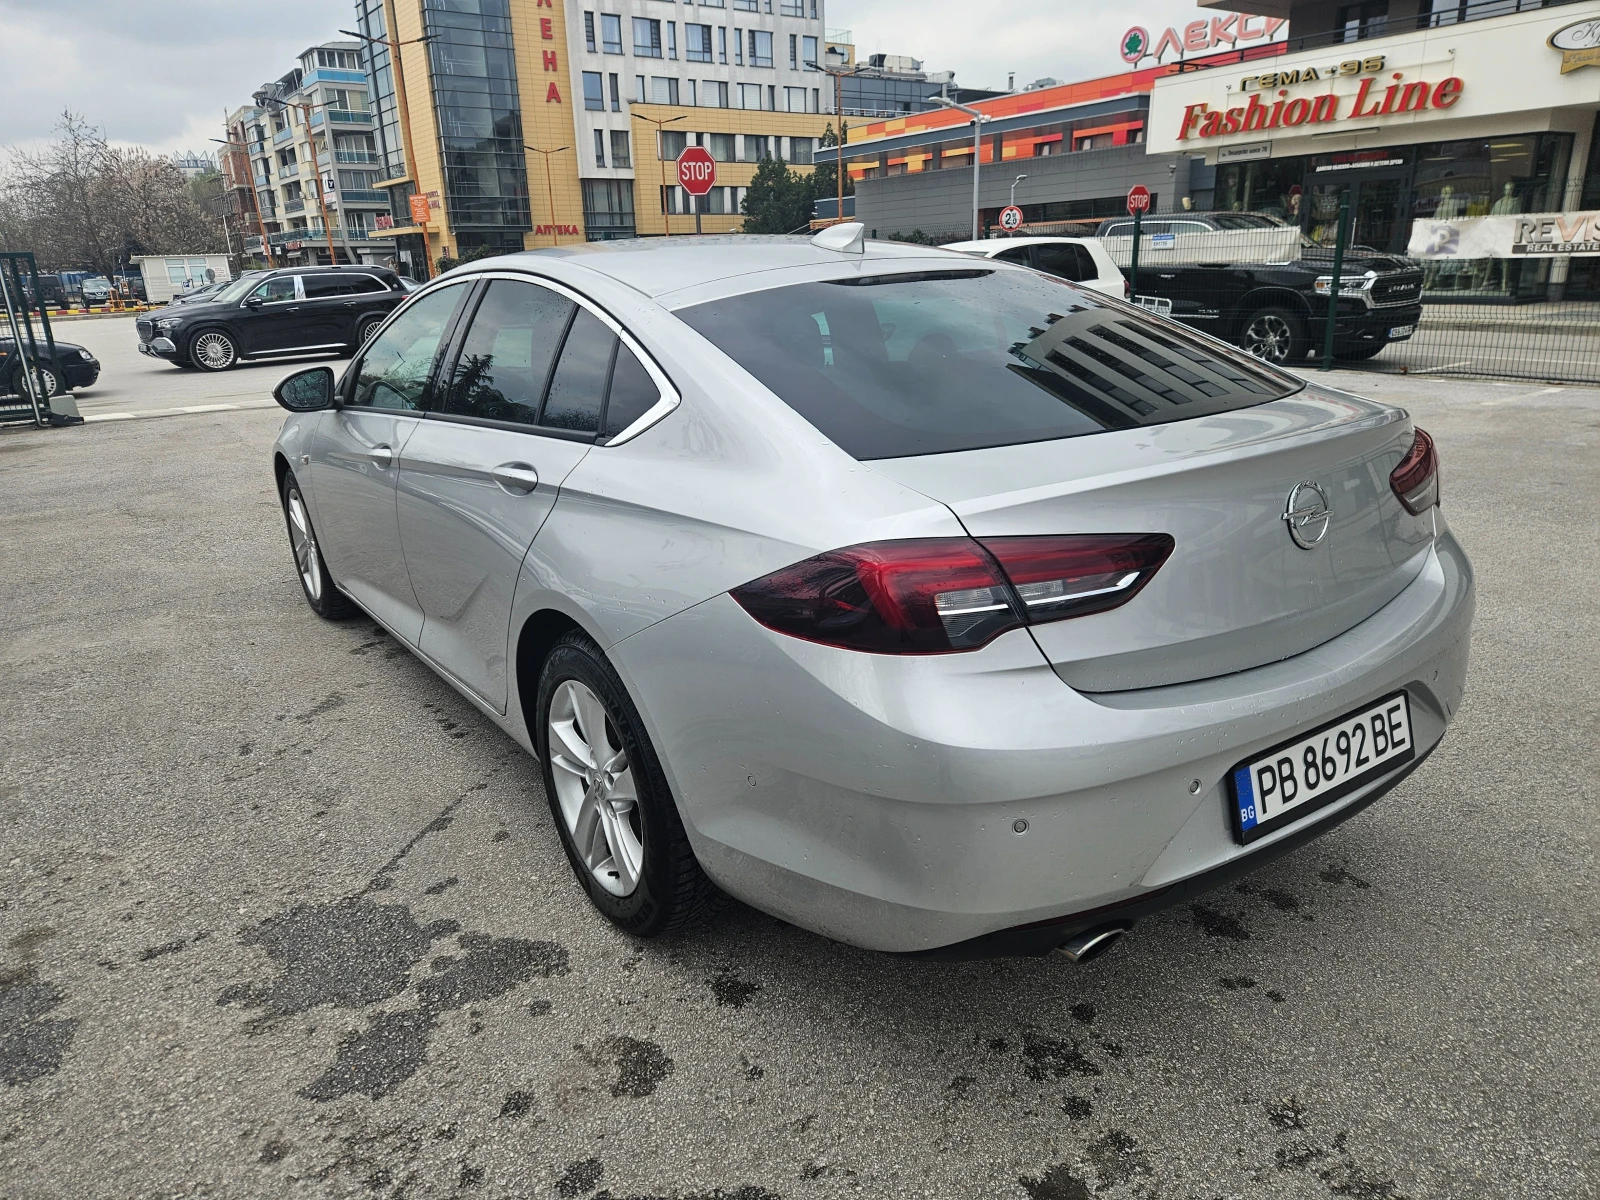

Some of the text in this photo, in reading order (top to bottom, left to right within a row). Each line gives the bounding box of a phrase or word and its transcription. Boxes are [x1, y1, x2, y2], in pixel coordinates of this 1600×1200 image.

[1176, 72, 1465, 141] Fashion Line
[681, 161, 713, 181] STOP
[1130, 195, 1148, 208] STOP
[1526, 243, 1600, 253] REAL ESTATE
[1257, 703, 1406, 815] PB 8692 BE
[1240, 805, 1255, 822] BG
